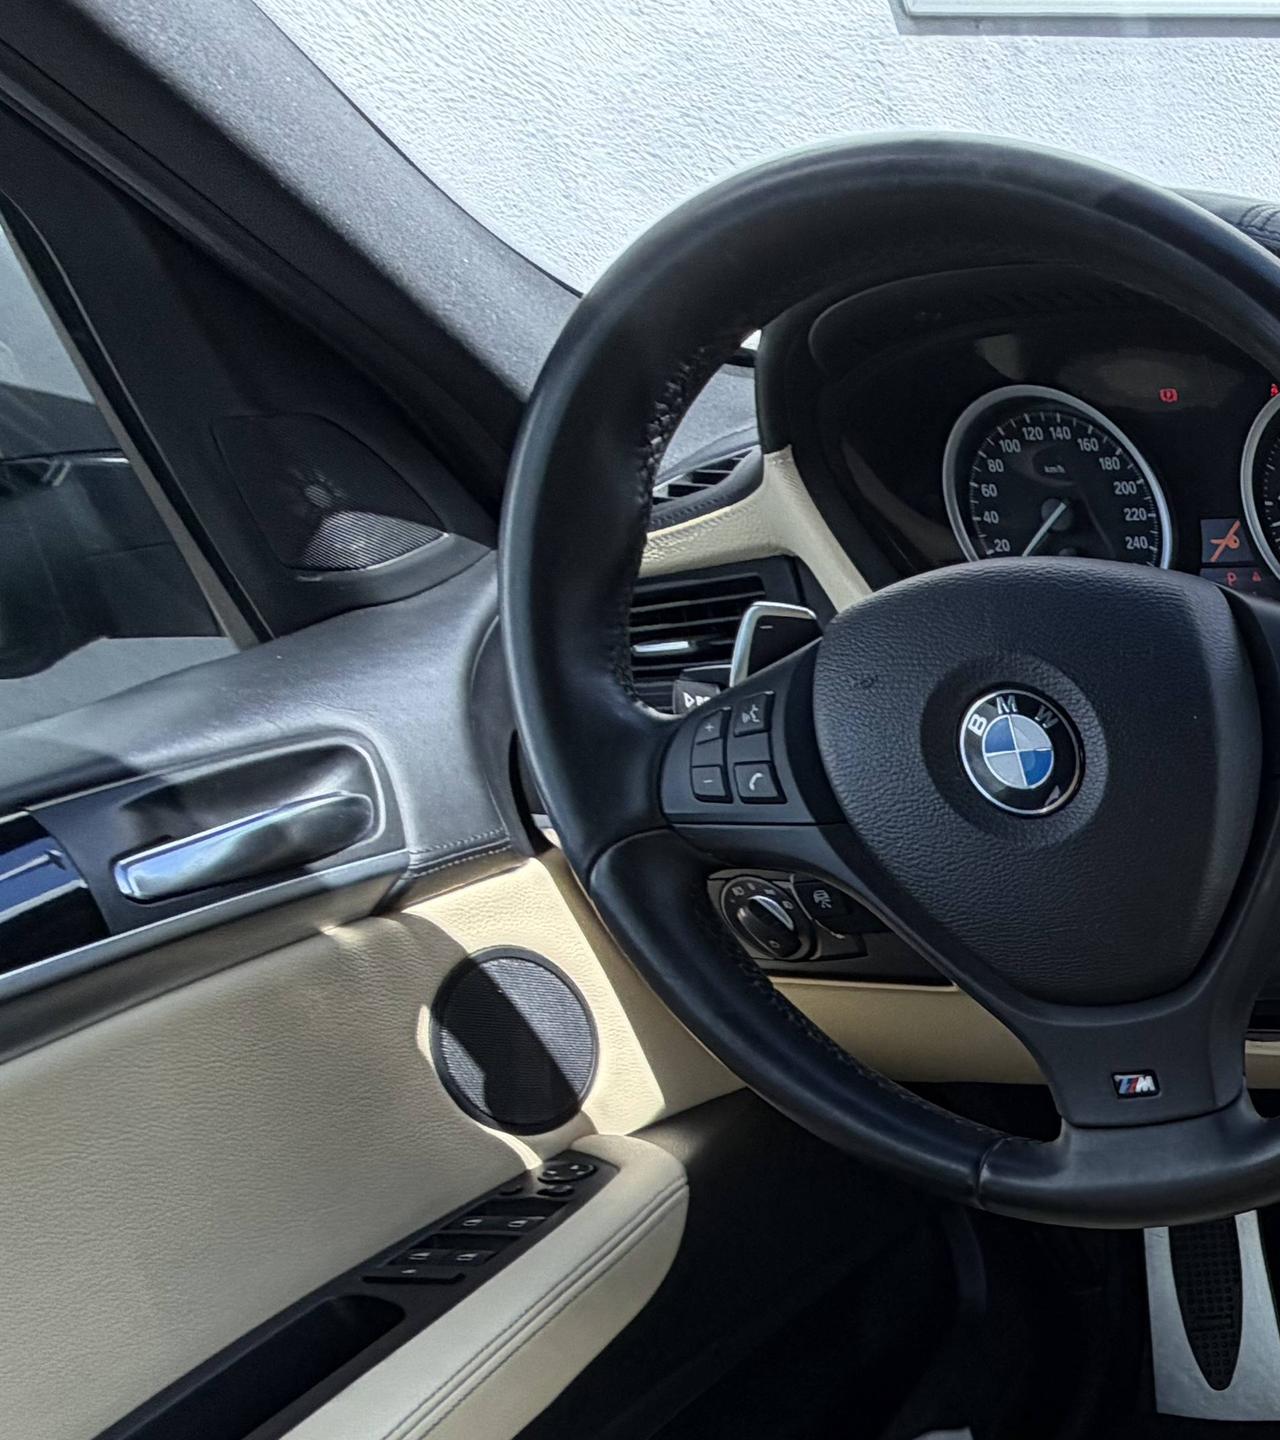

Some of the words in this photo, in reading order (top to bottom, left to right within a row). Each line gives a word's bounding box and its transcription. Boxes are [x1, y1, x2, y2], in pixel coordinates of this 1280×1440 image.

[1022, 427, 1044, 440] 120
[1050, 426, 1072, 440] 140
[1000, 438, 1021, 452] 100
[1077, 438, 1099, 452] 160
[987, 460, 1004, 473] 80
[1099, 457, 1121, 470] 180
[981, 484, 997, 497] 60
[1113, 481, 1137, 495] 200
[983, 510, 999, 524] 40
[1124, 508, 1147, 521] 220
[994, 539, 1010, 552] 20
[1125, 535, 1148, 549] 240
[967, 695, 1059, 736] BMW
